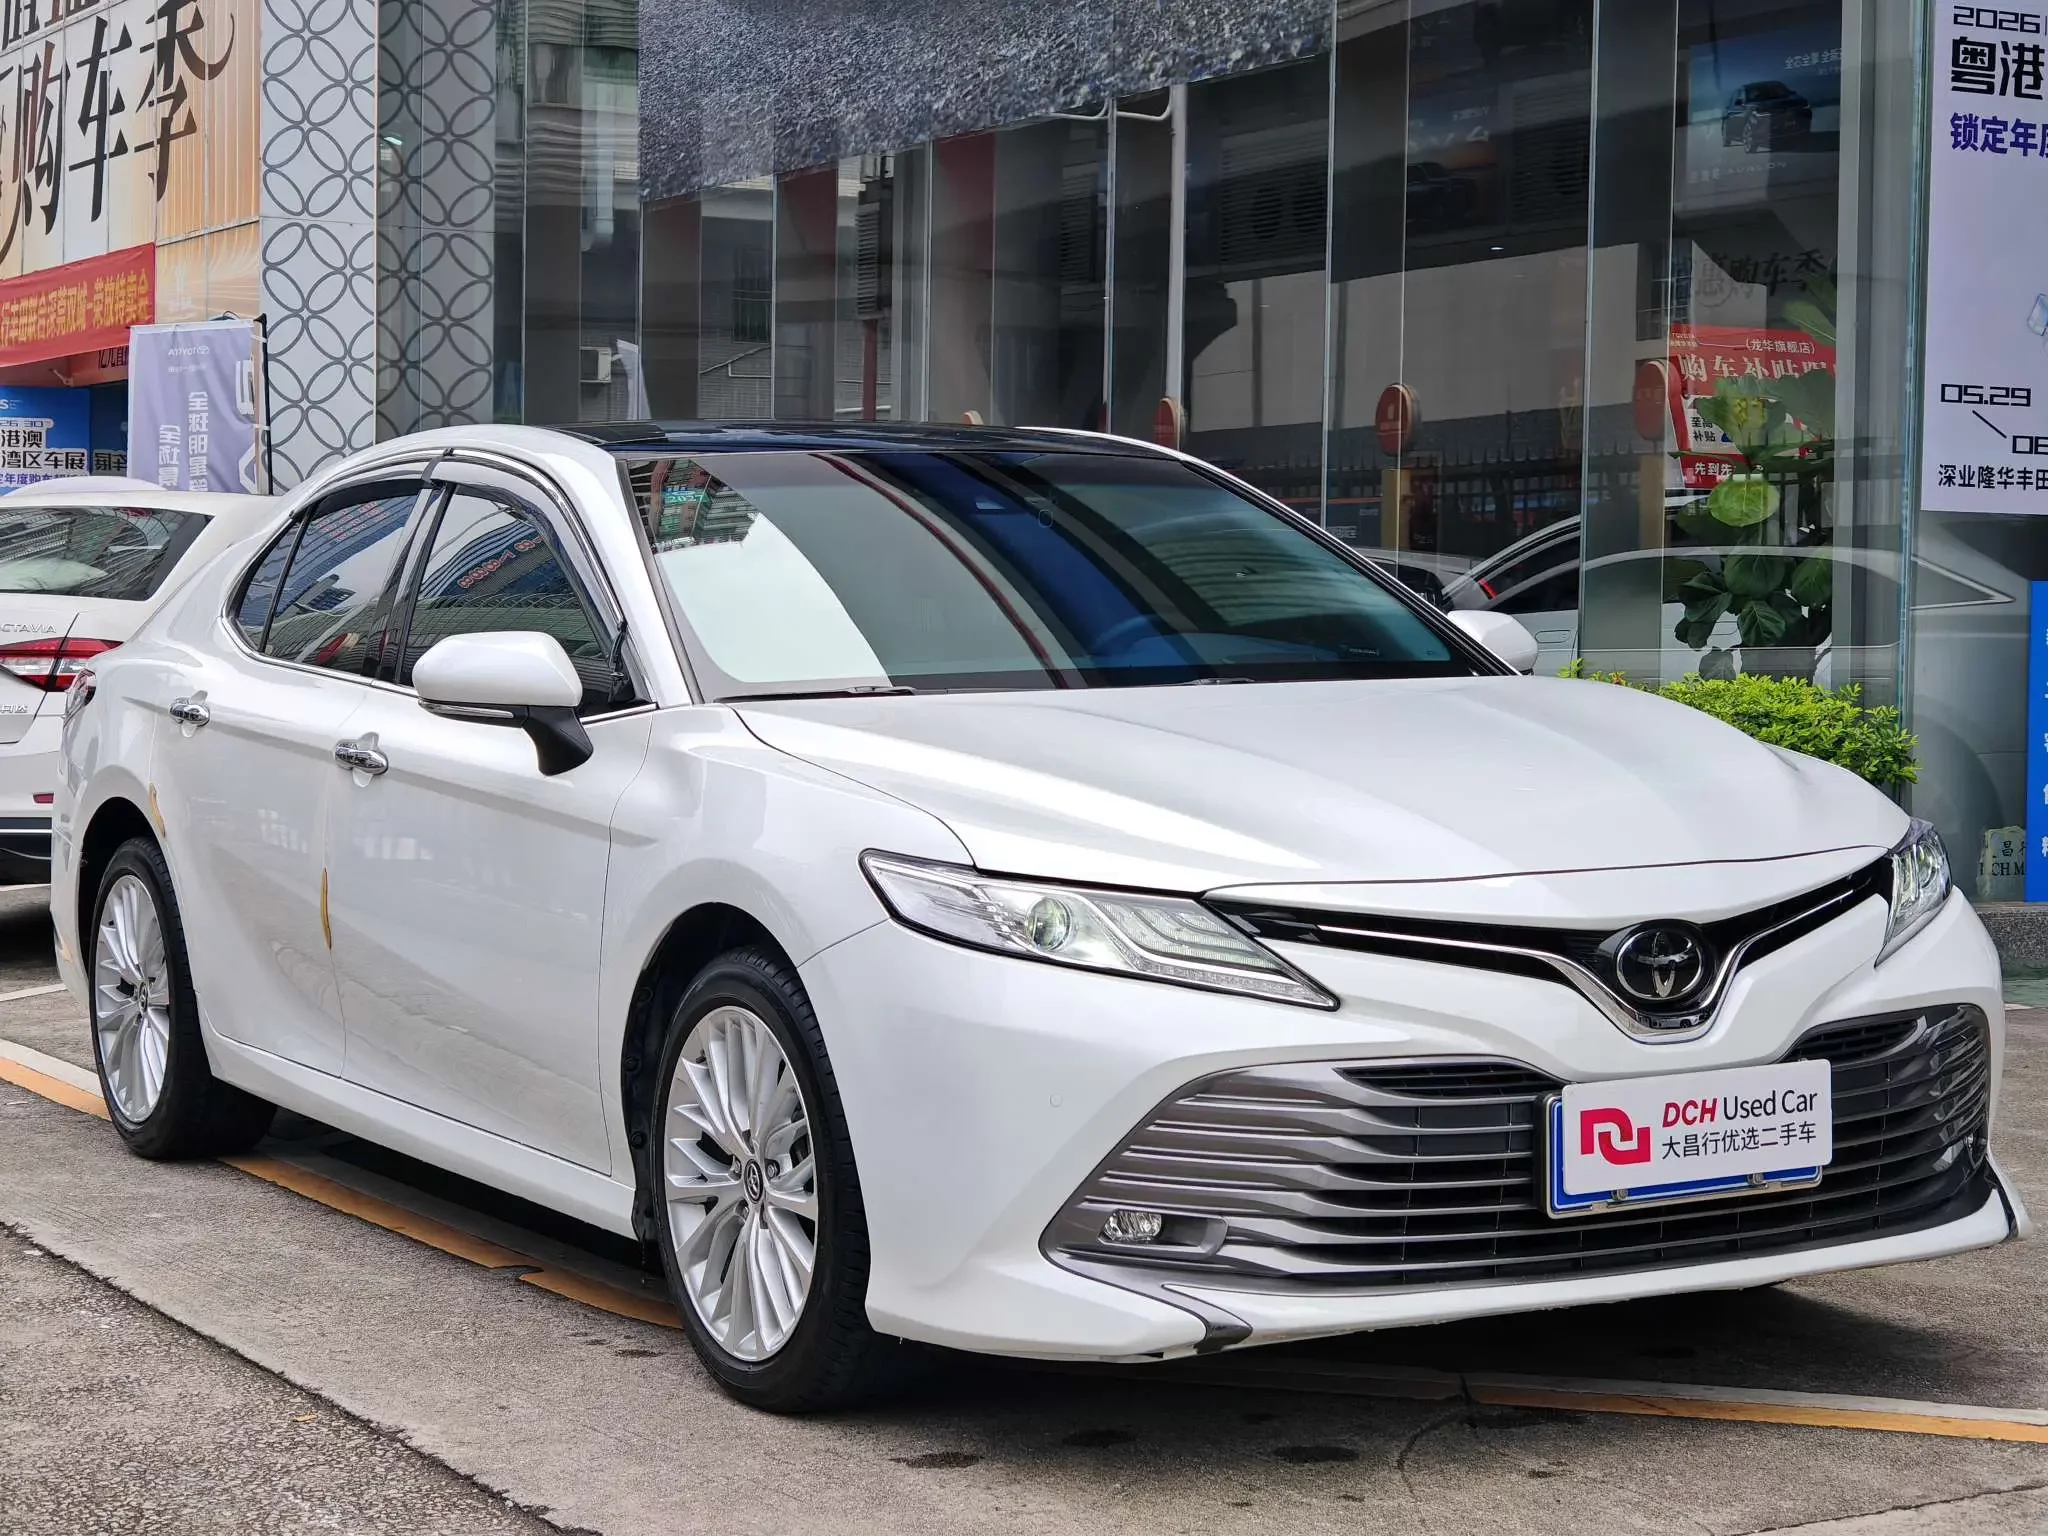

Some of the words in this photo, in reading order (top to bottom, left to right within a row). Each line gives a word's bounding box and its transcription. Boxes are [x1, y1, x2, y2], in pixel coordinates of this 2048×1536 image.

[1953, 5, 2041, 34] 2026
[1951, 36, 2046, 101] 粤港
[1940, 383, 2032, 408] 05.29
[1693, 429, 1716, 443] 补贴
[1938, 463, 2048, 491] 深业隆华丰田
[1662, 1098, 1718, 1128] DCH
[1723, 1090, 1777, 1120] Used
[1782, 1089, 1818, 1114] Car
[1662, 1121, 1817, 1160] 大昌行优选二手车
